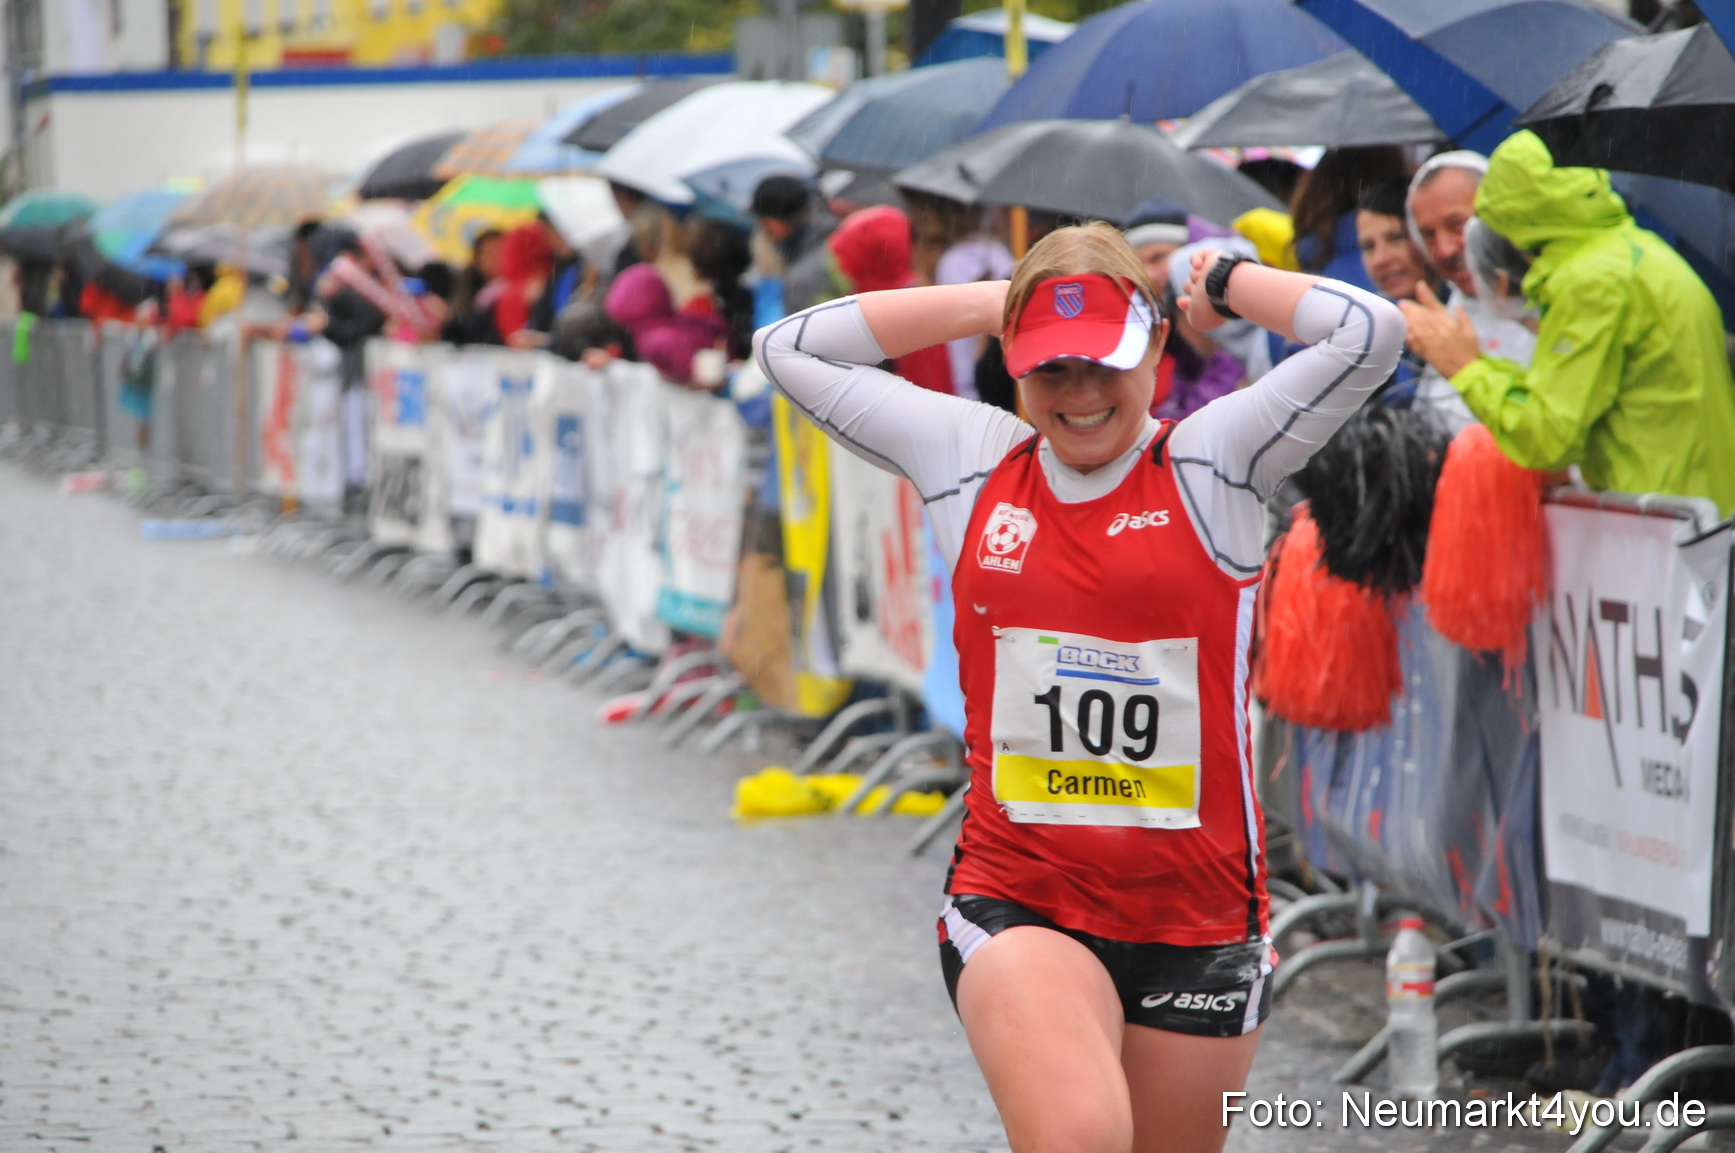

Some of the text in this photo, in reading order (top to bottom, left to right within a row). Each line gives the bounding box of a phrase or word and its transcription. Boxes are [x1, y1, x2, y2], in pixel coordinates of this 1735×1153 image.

[982, 555, 1020, 571] AHLEN
[1057, 646, 1140, 672] BOCK
[1034, 685, 1159, 761] 109
[1001, 741, 1010, 752] A
[1047, 769, 1147, 799] Carmen
[1173, 992, 1236, 1012] asics
